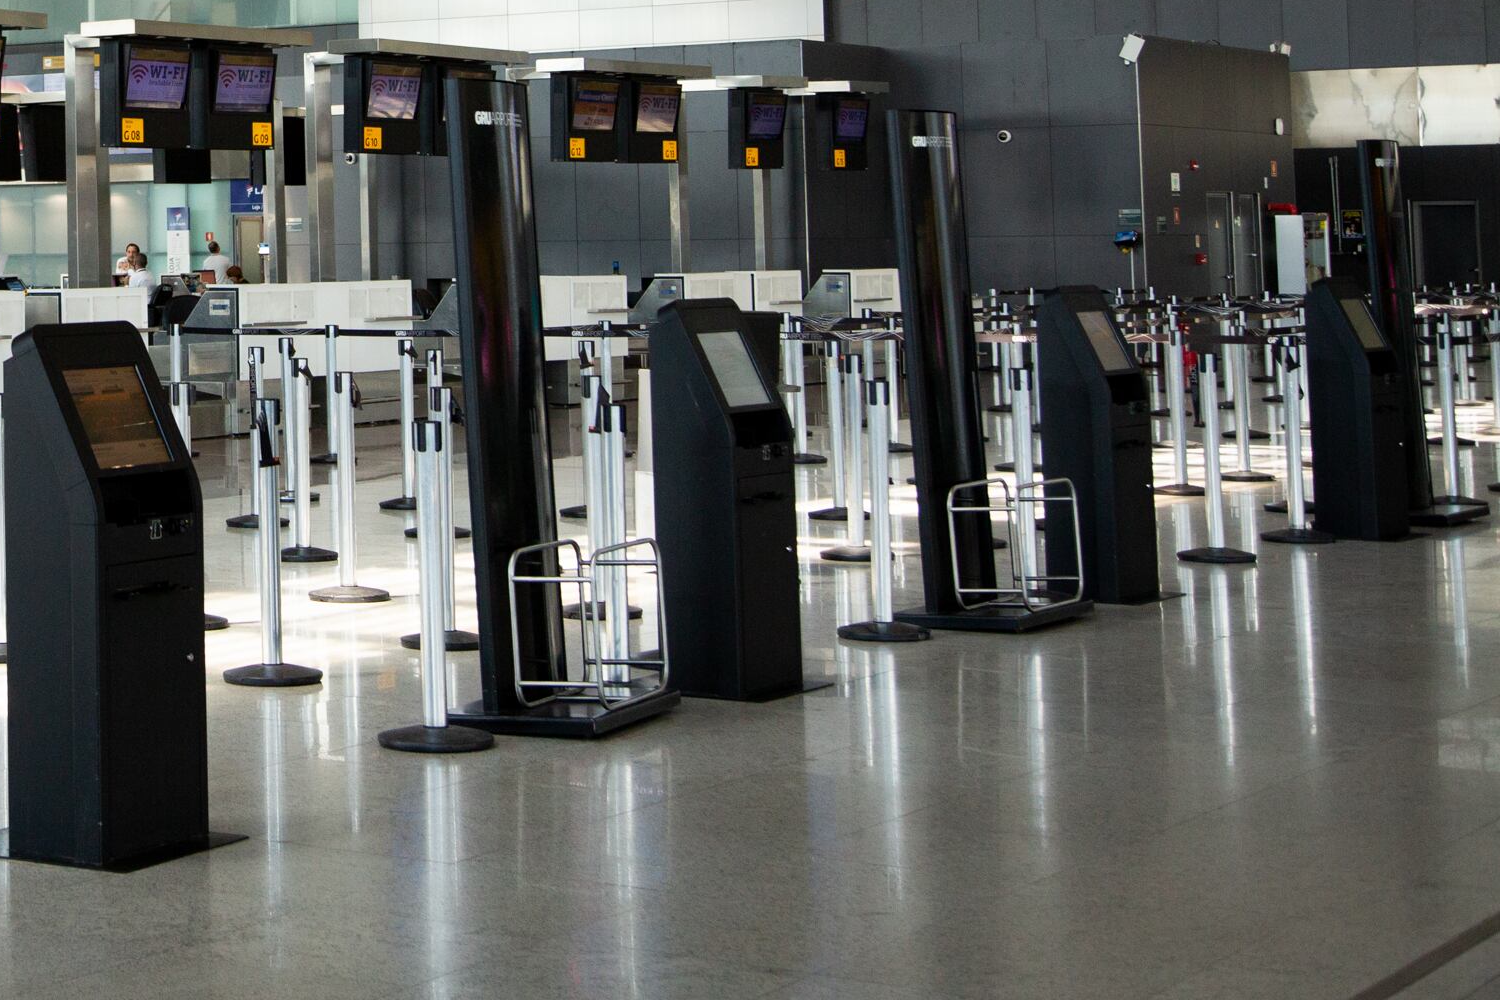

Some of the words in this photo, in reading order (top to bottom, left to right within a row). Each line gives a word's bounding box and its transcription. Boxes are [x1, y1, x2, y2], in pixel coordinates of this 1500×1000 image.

[150, 64, 186, 80] WI-FI
[238, 70, 271, 84] WI-FI
[388, 80, 418, 92] WI-FI
[653, 96, 676, 110] WI-FI
[124, 130, 130, 140] G
[131, 130, 140, 140] 08
[254, 134, 258, 144] G
[260, 134, 268, 144] 09
[365, 138, 370, 146] G
[371, 138, 378, 147] 10
[572, 147, 576, 156] G
[576, 147, 582, 156] 12
[666, 150, 670, 158] G
